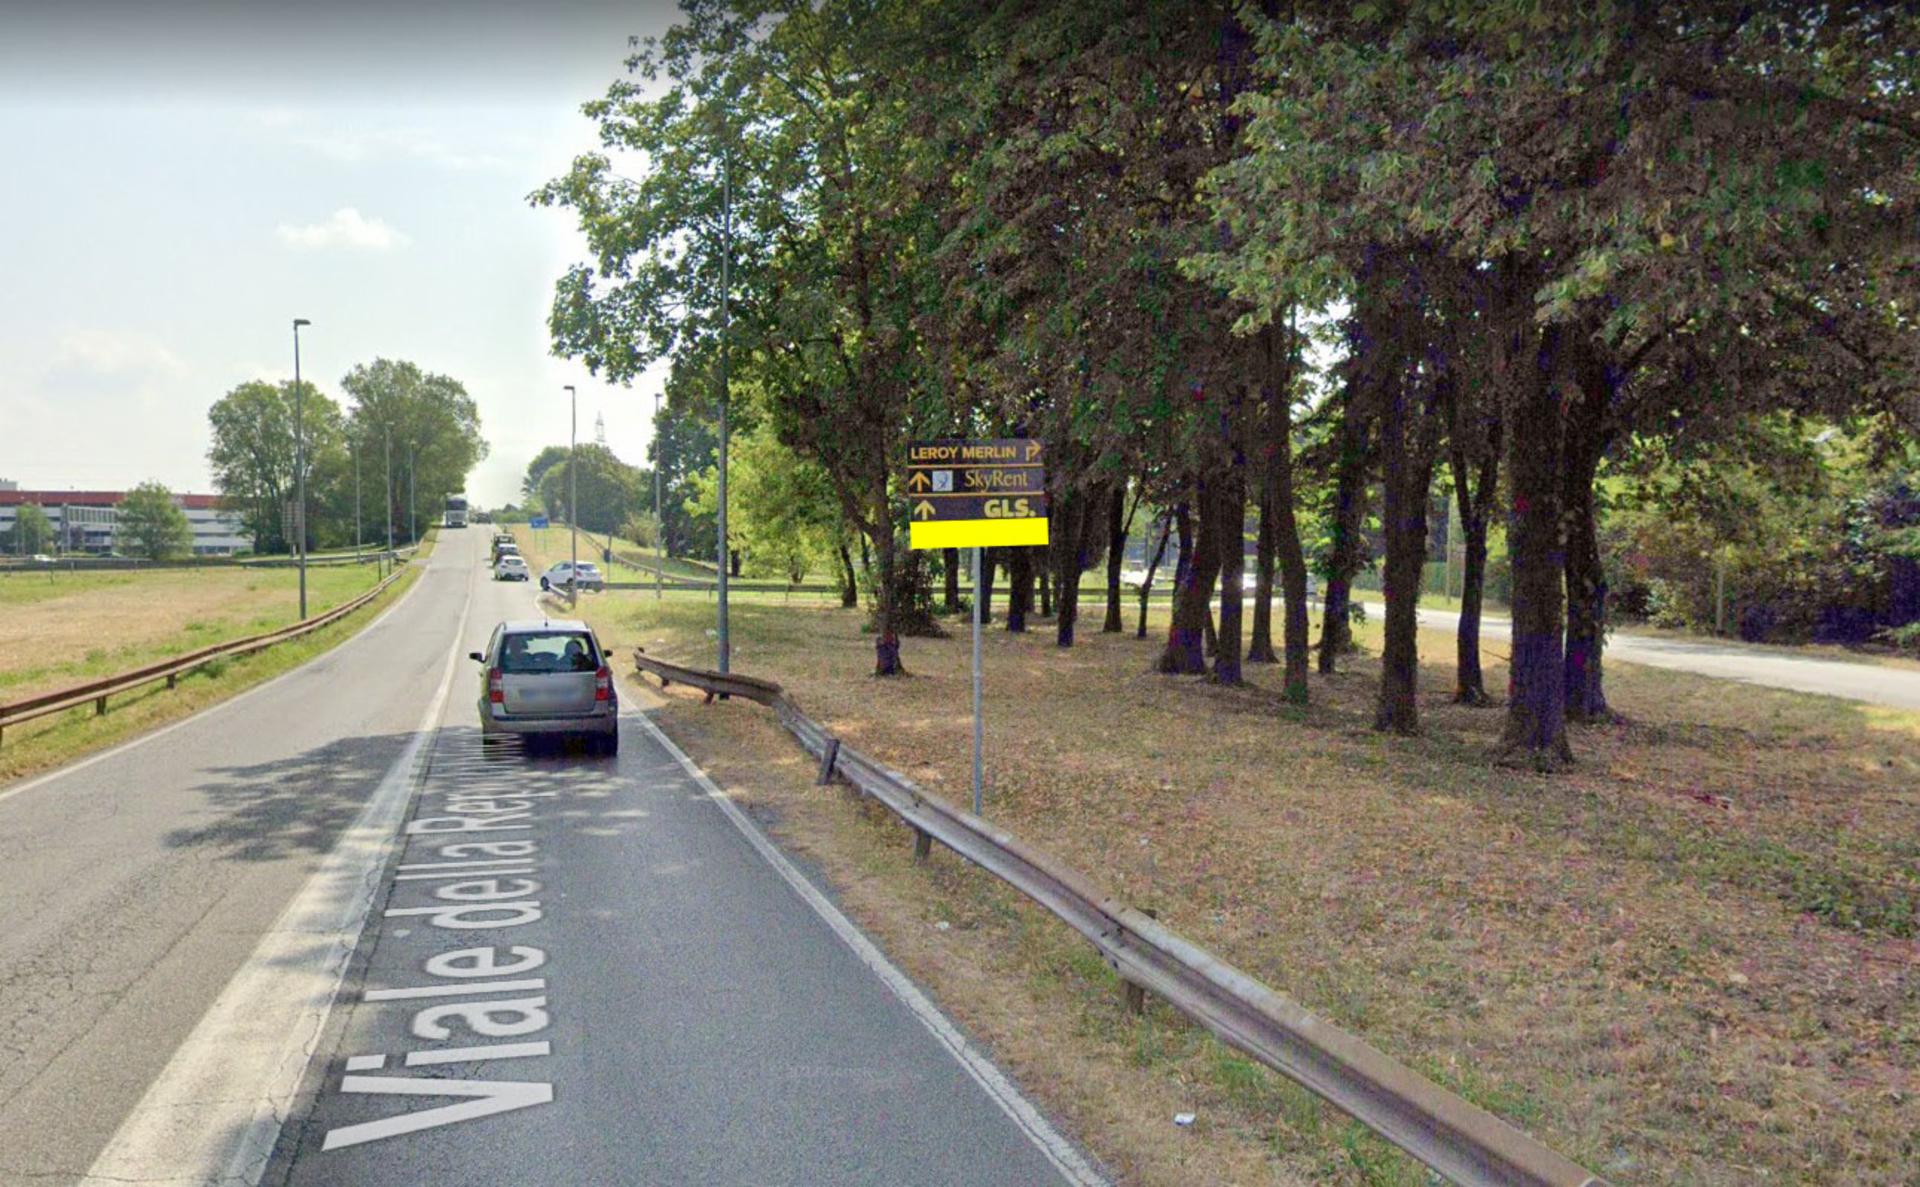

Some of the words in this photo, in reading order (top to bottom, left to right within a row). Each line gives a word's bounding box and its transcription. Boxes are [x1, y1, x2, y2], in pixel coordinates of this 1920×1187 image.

[911, 447, 958, 460] LEROY
[962, 446, 1017, 459] MERLIN
[963, 470, 1028, 490] SkyRent
